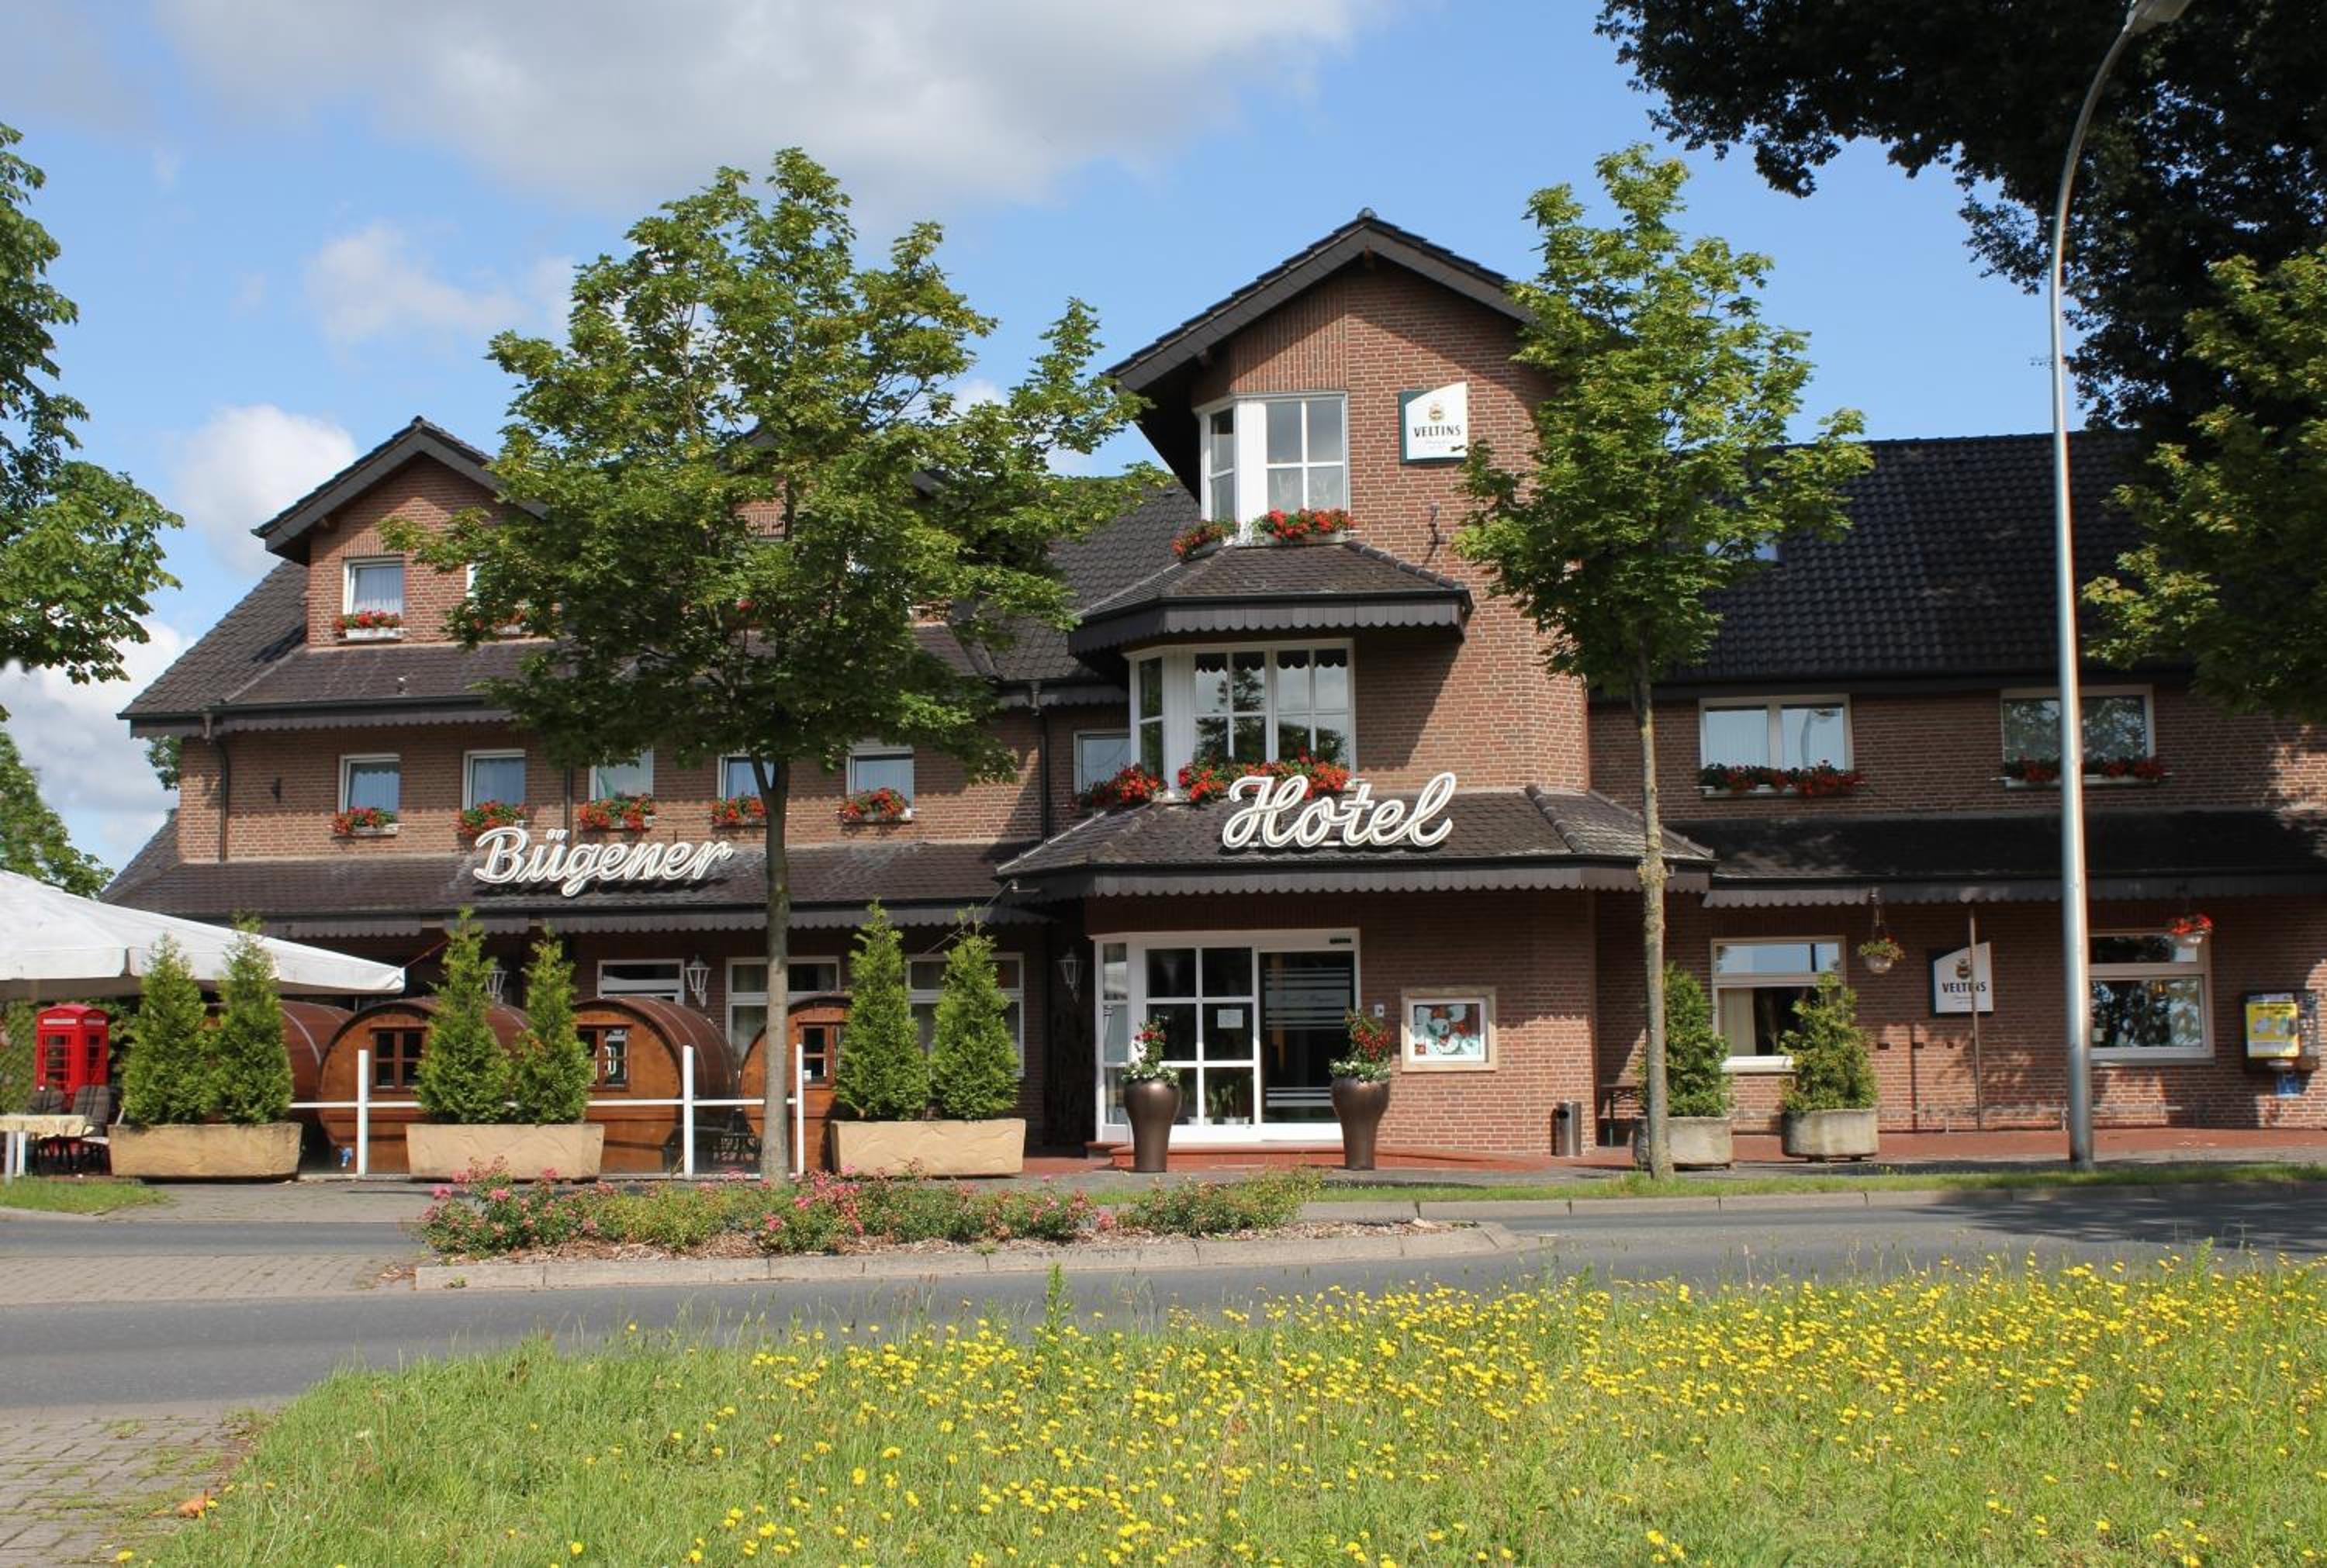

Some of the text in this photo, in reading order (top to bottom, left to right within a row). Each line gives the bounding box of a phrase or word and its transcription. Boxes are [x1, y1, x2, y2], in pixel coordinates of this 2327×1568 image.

[1414, 425, 1461, 437] VELTINS
[1222, 772, 1457, 848] Hotel
[473, 826, 734, 897] Bügener
